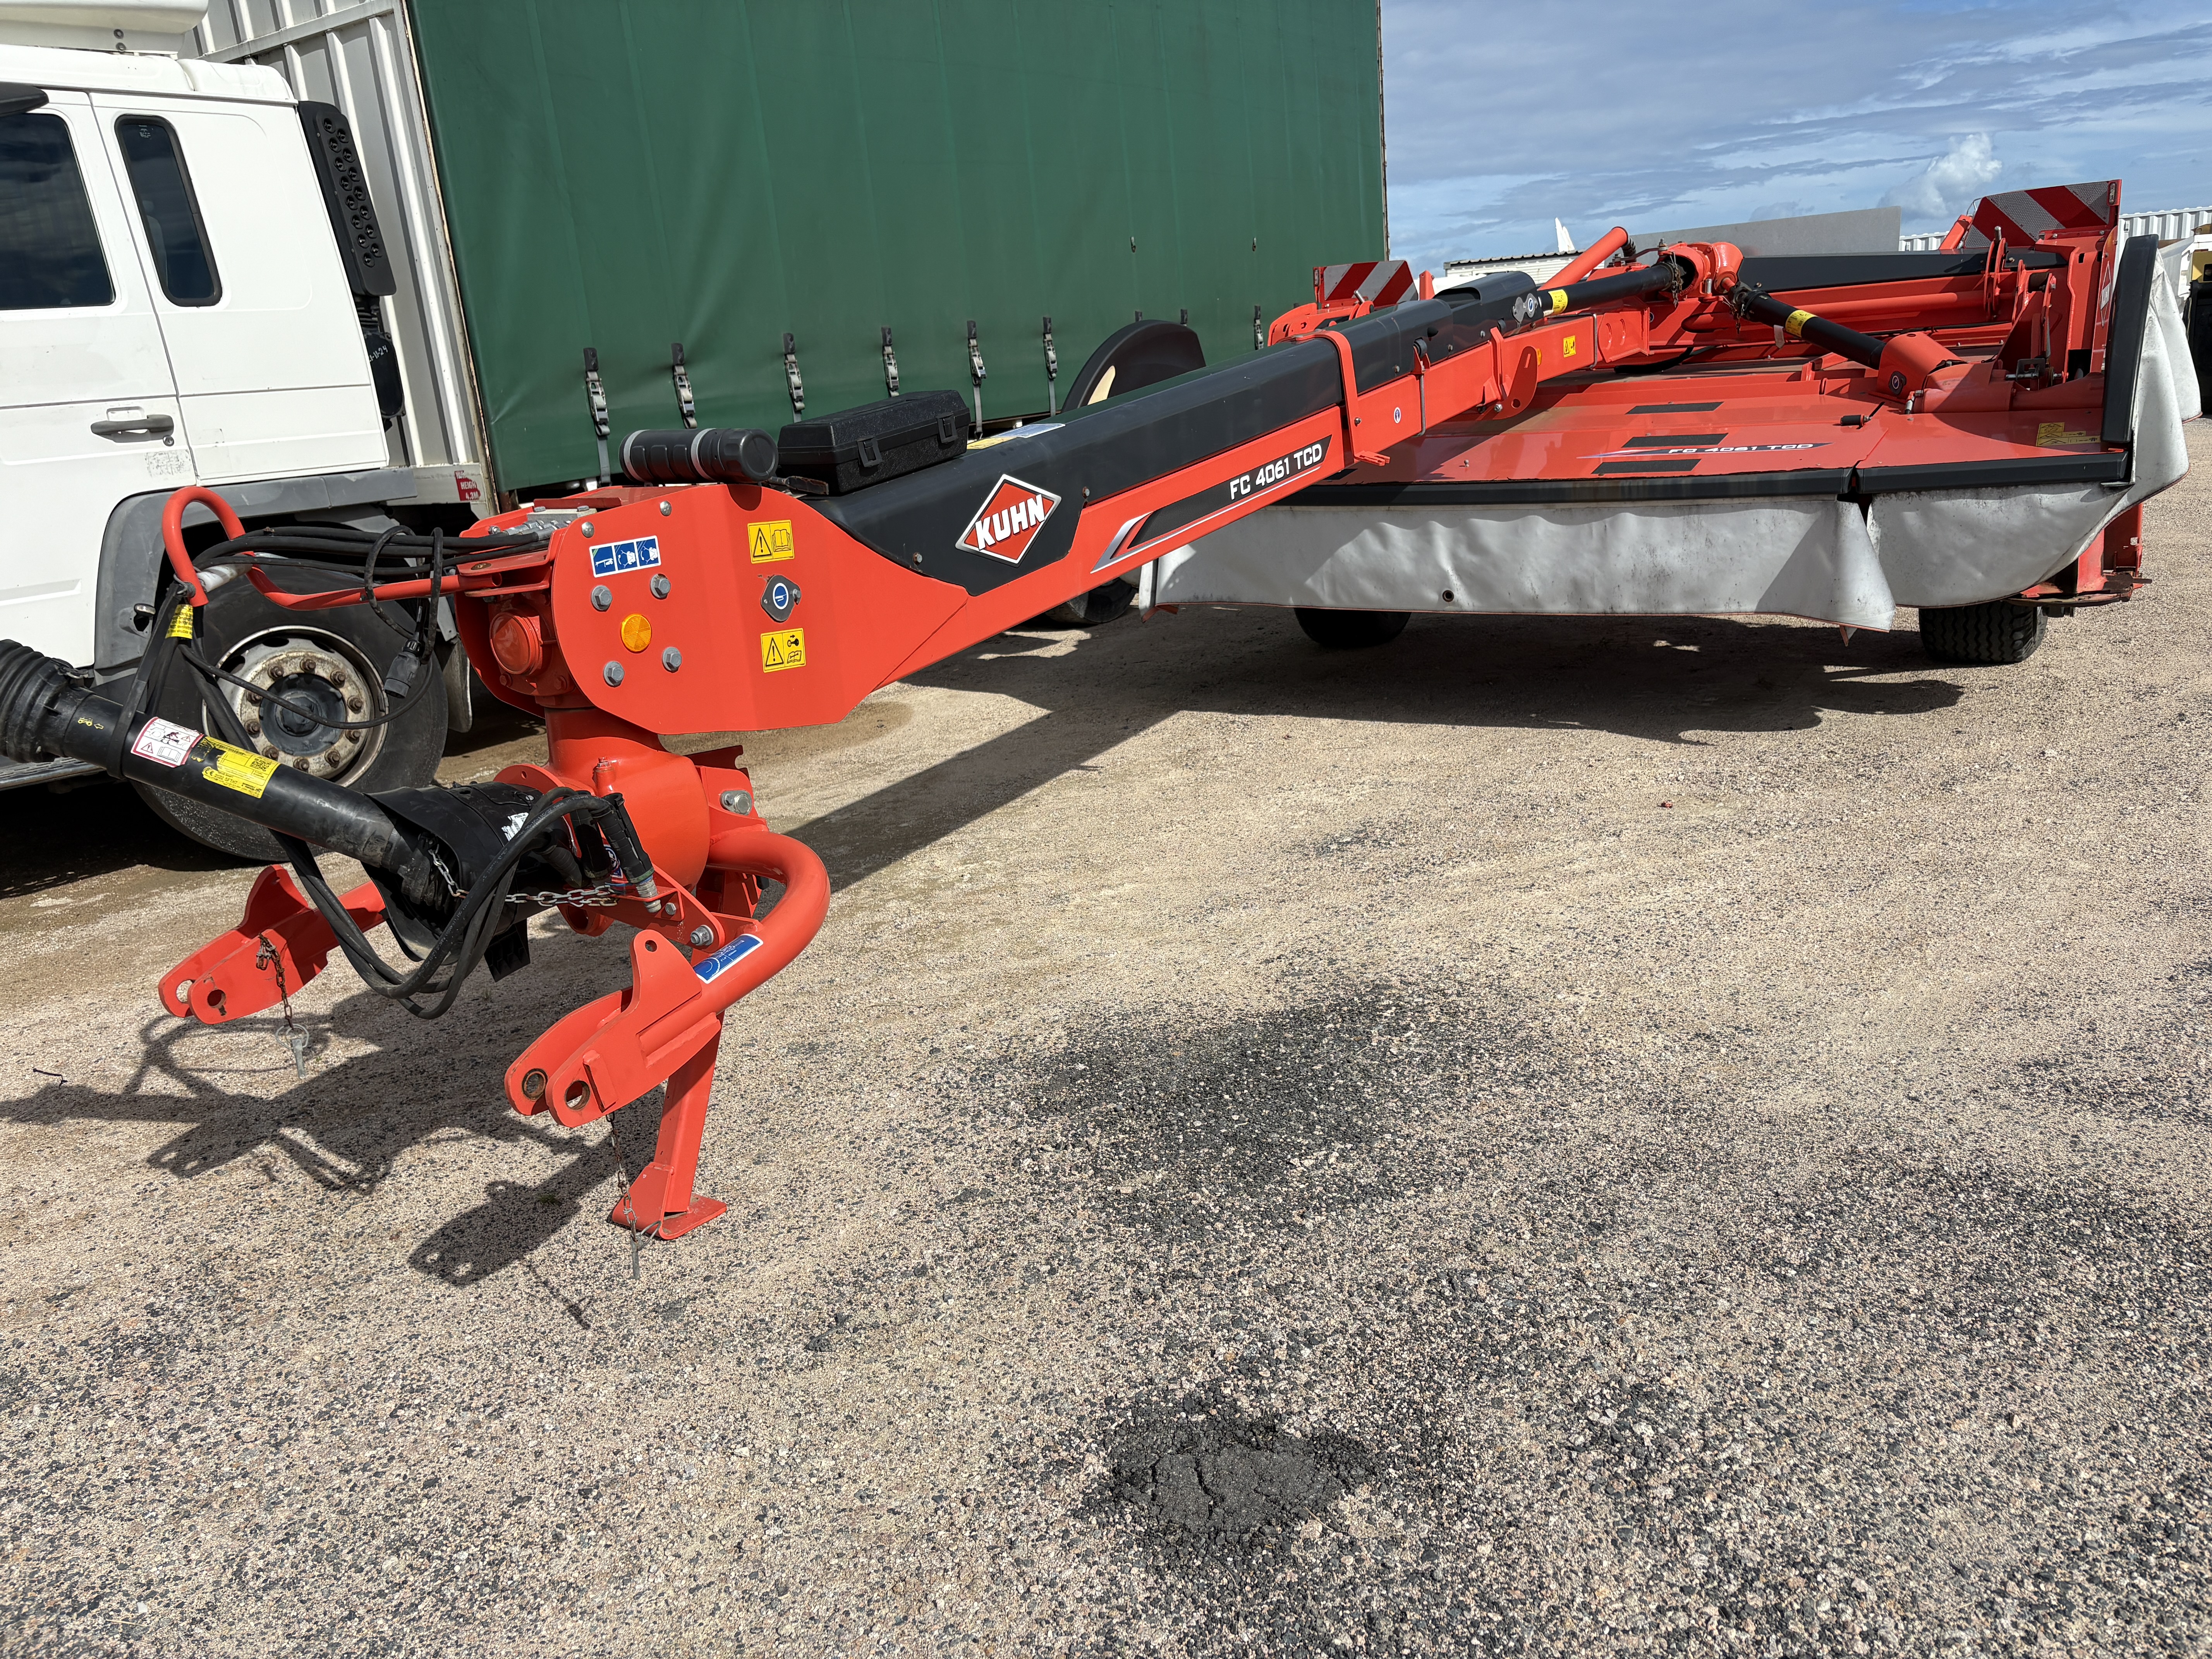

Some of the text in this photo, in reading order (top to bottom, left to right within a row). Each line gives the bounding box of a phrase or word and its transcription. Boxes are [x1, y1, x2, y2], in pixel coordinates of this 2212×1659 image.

[369, 345, 388, 362] 1-11-24
[460, 481, 477, 490] HEIGH
[1230, 444, 1322, 500] FC 4061 TCD
[975, 494, 1045, 551] KUHN
